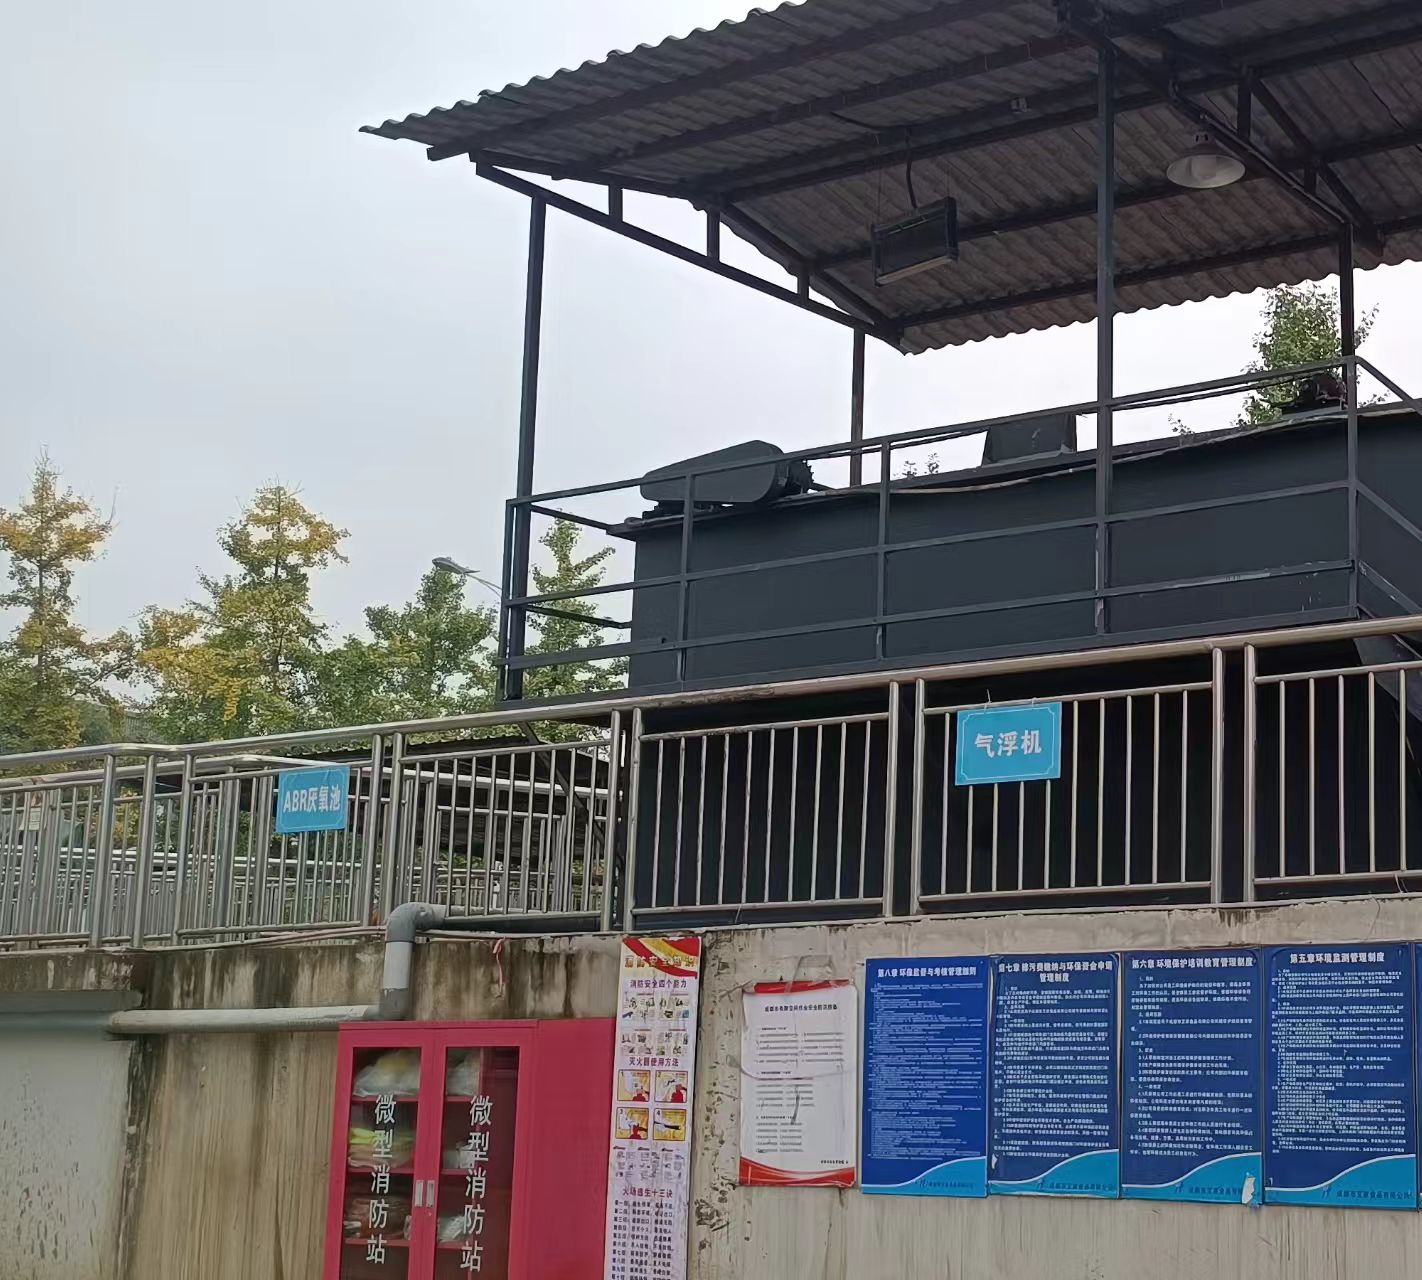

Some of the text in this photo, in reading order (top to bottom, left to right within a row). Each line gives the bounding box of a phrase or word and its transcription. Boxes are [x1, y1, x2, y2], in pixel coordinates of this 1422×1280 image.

[974, 729, 1042, 758] 气浮机
[283, 784, 341, 813] ABR厌氧池
[1289, 951, 1385, 964] 第五章环境监测管理制度
[998, 963, 1020, 973] 第七章
[1131, 959, 1155, 969] 第六章
[877, 968, 898, 978] 第八章
[1039, 972, 1070, 983] 管理制度
[630, 979, 687, 989] 消防安全四个能力
[629, 1057, 679, 1067] 灭火器使用方法
[365, 1094, 397, 1264] 微型消防站
[460, 1095, 493, 1272] 微型消防站
